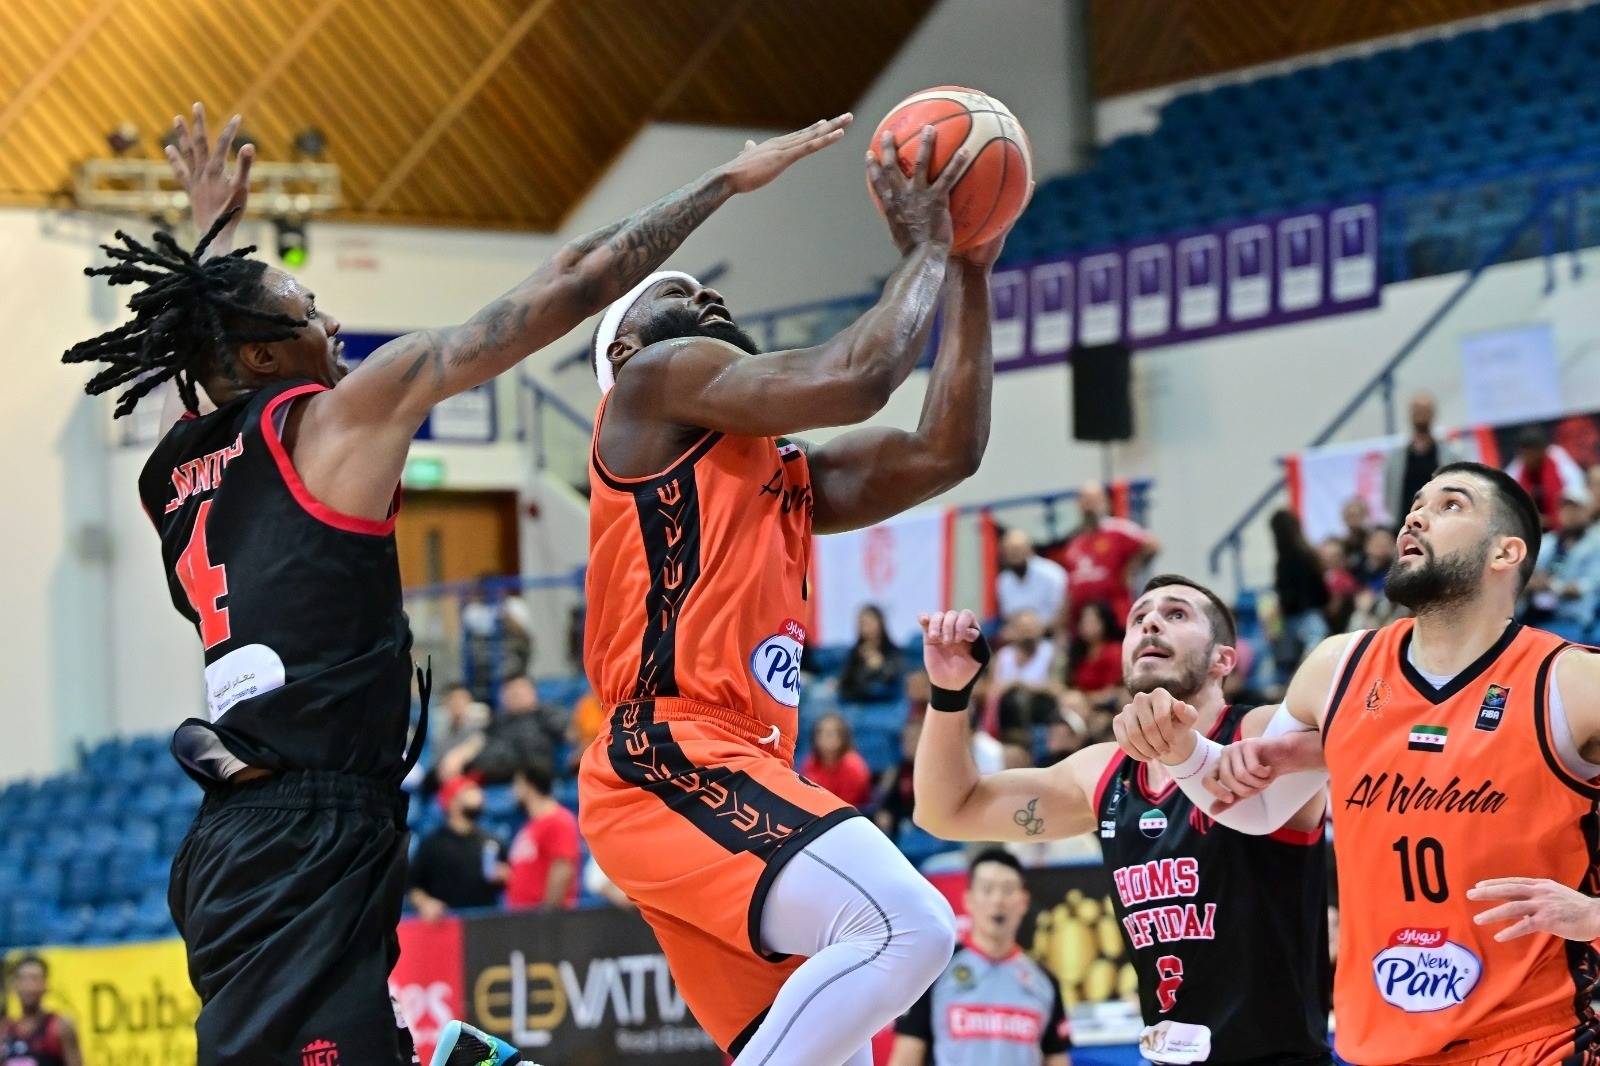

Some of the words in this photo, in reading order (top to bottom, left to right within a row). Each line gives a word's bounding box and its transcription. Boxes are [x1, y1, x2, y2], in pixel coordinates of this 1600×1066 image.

[175, 498, 232, 652] 4
[1480, 708, 1500, 720] FIBA
[1345, 771, 1389, 812] Al
[1386, 772, 1509, 815] Wahda
[1113, 857, 1199, 908] HOMS
[1392, 835, 1449, 903] 10
[1396, 928, 1442, 946] نيوبارك
[1377, 957, 1465, 1002] Park
[1416, 951, 1453, 969] New
[1156, 954, 1184, 1013] 6
